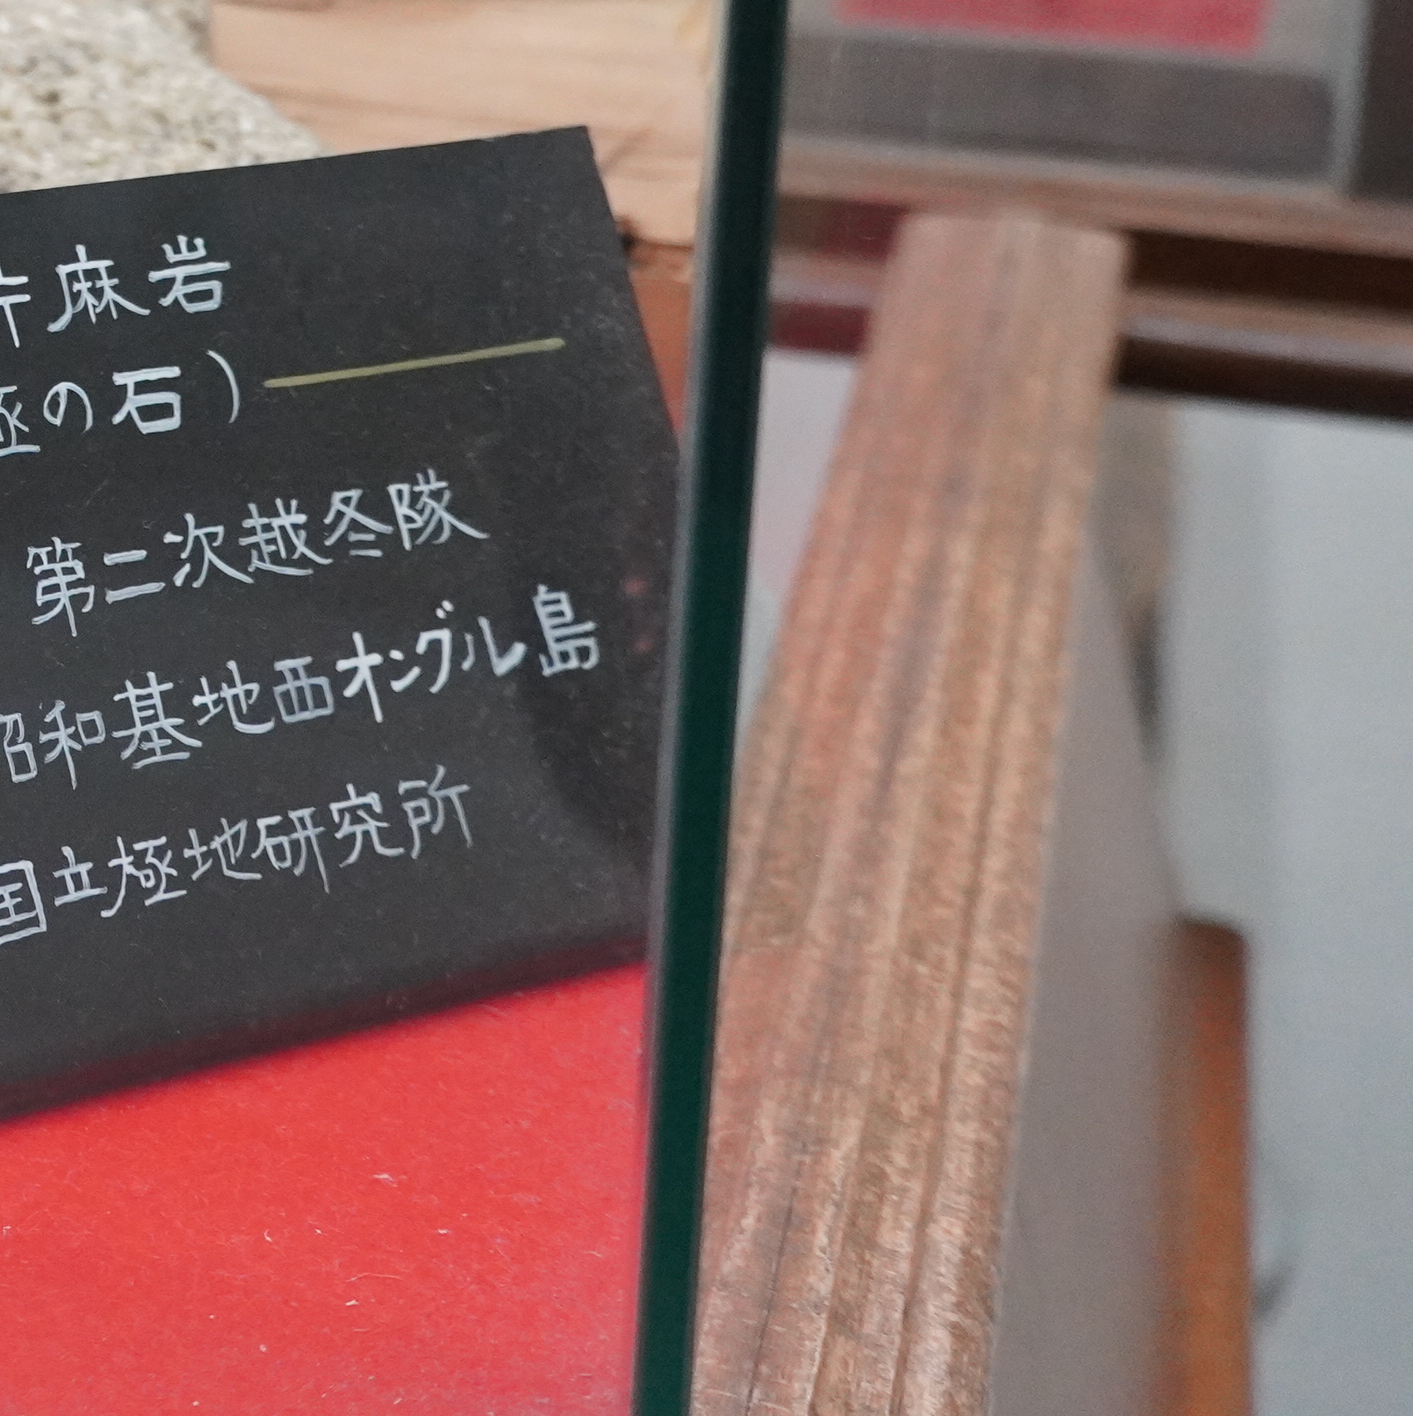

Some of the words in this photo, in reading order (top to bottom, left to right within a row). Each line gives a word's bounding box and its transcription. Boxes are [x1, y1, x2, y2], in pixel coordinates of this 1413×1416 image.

[26, 468, 489, 637] 第二次越冬隊
